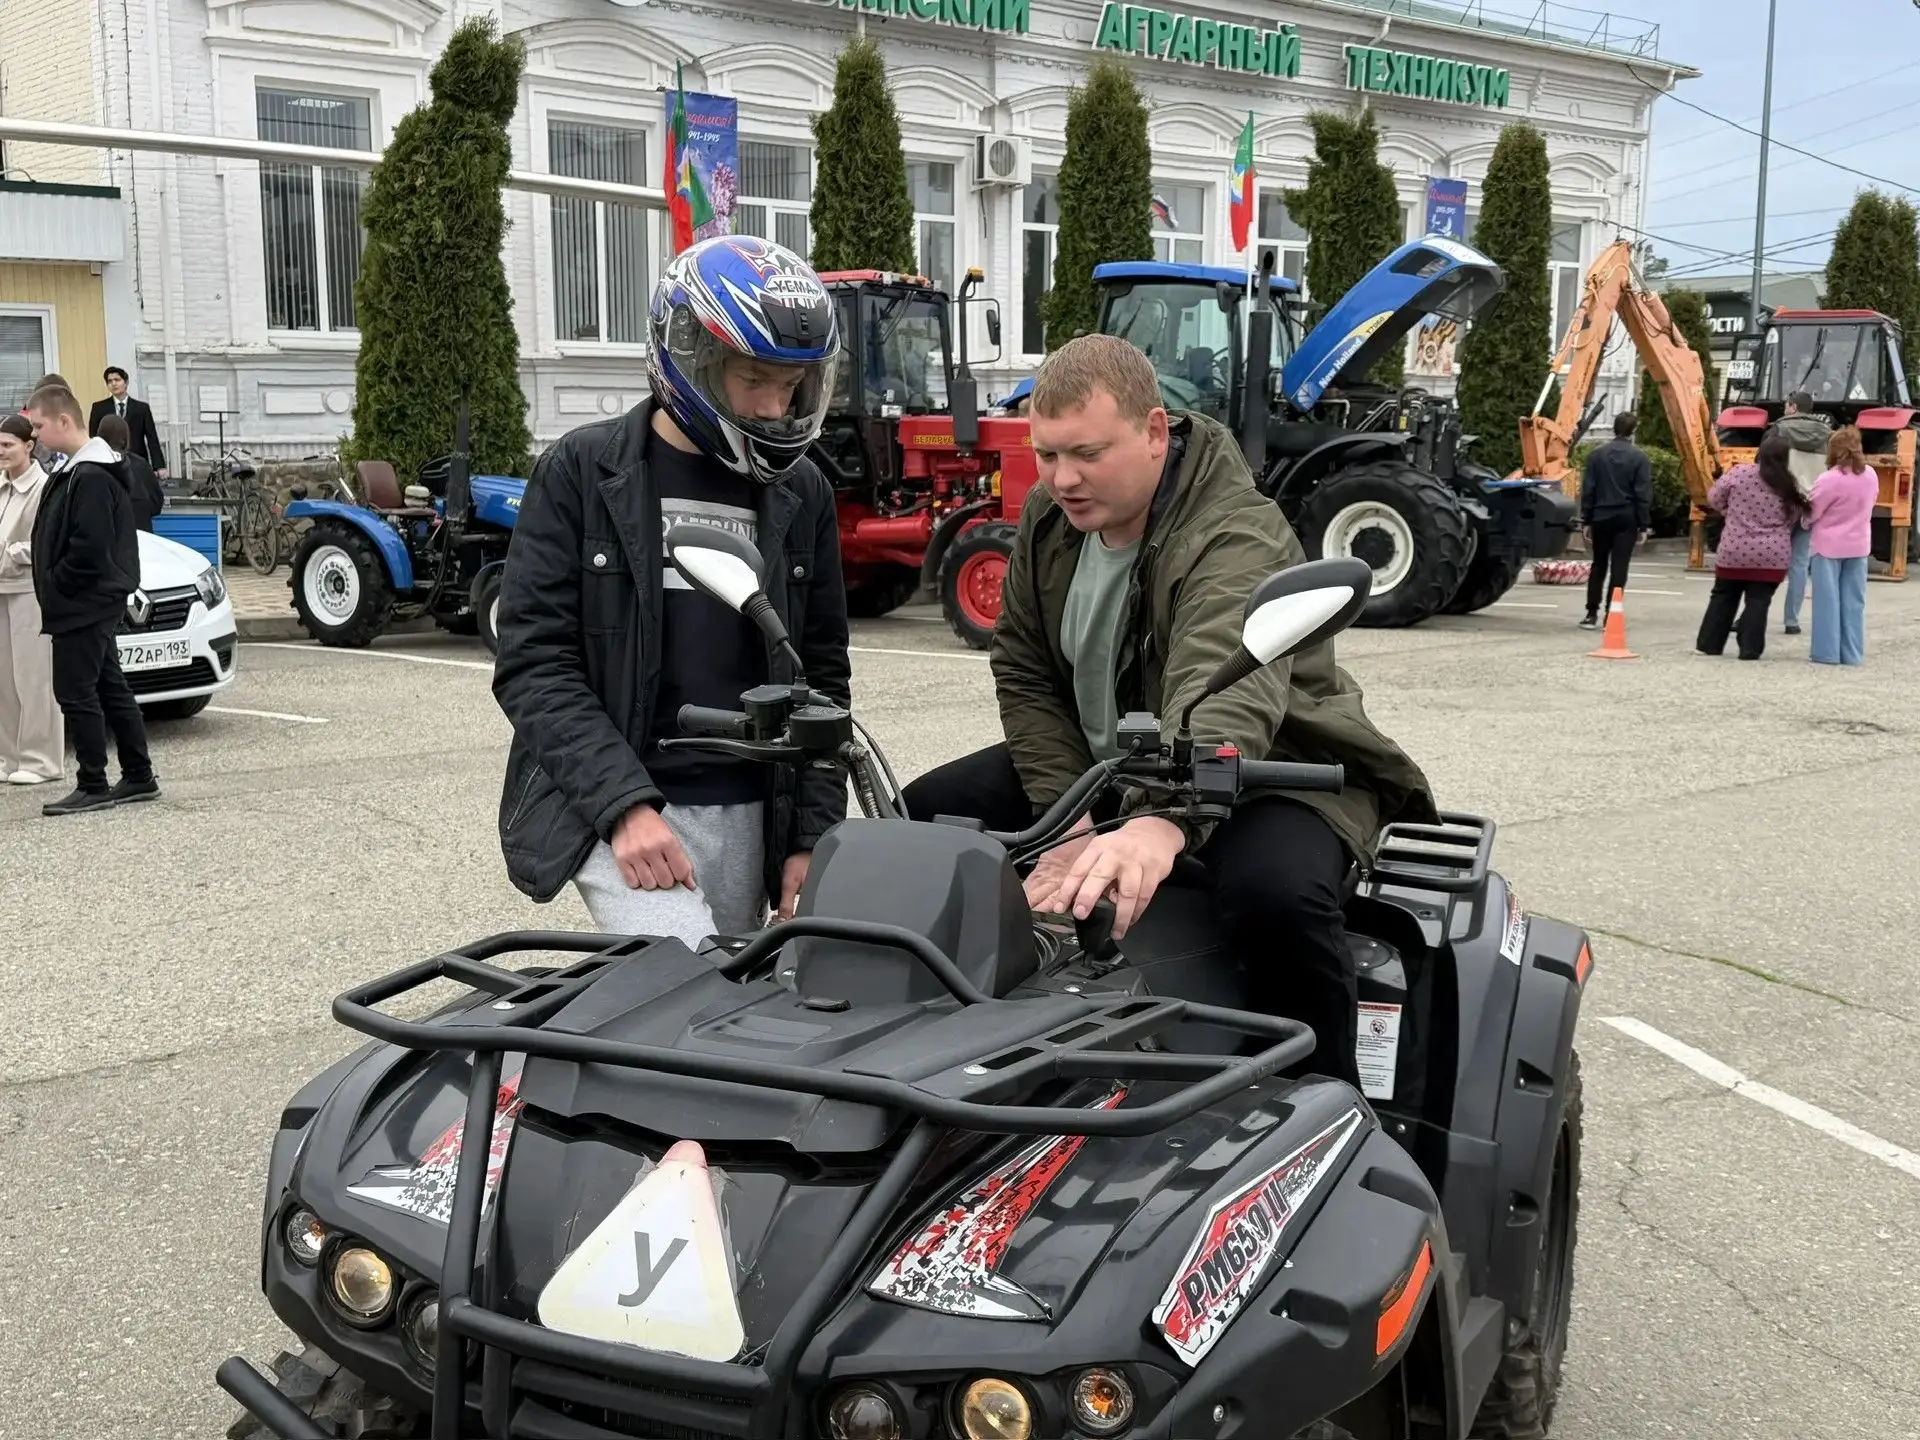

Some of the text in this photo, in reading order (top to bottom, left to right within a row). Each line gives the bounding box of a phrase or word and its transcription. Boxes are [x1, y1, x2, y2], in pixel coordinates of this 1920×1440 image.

[1094, 2, 1302, 78] АГРАРНЫЙ
[1344, 45, 1510, 109] ТЕХНИКУМ
[687, 130, 720, 143] 941-1945
[1707, 316, 1745, 334] ОСТИ
[1318, 336, 1363, 389] New Holland
[166, 641, 187, 656] 193
